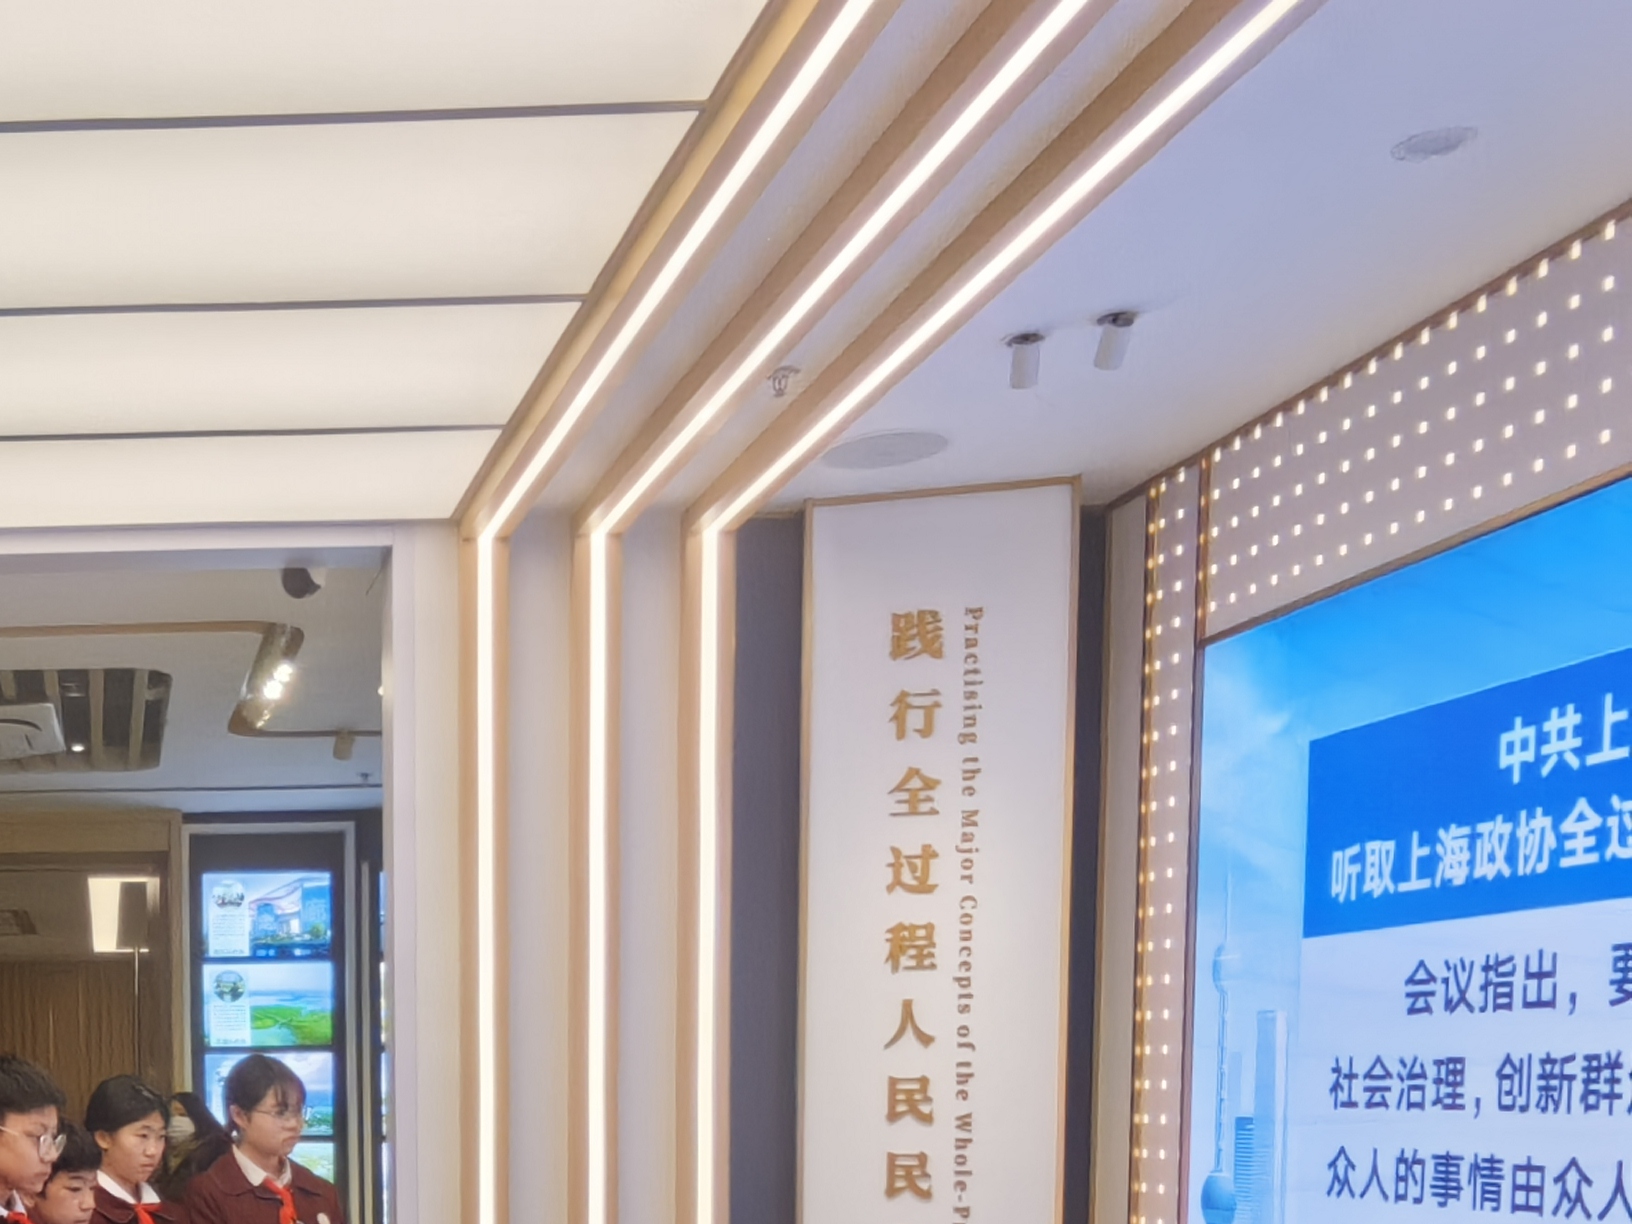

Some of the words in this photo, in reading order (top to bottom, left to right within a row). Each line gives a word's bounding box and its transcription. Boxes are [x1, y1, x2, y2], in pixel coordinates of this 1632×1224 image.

[957, 606, 984, 745] Practising
[1498, 692, 1631, 784] 中共上
[960, 756, 981, 797] the
[955, 808, 980, 885] Major
[952, 894, 978, 1015] Concepts
[955, 1024, 975, 1051] of
[954, 1060, 975, 1101] the
[1329, 1050, 1632, 1119] 社会治理，创新群
